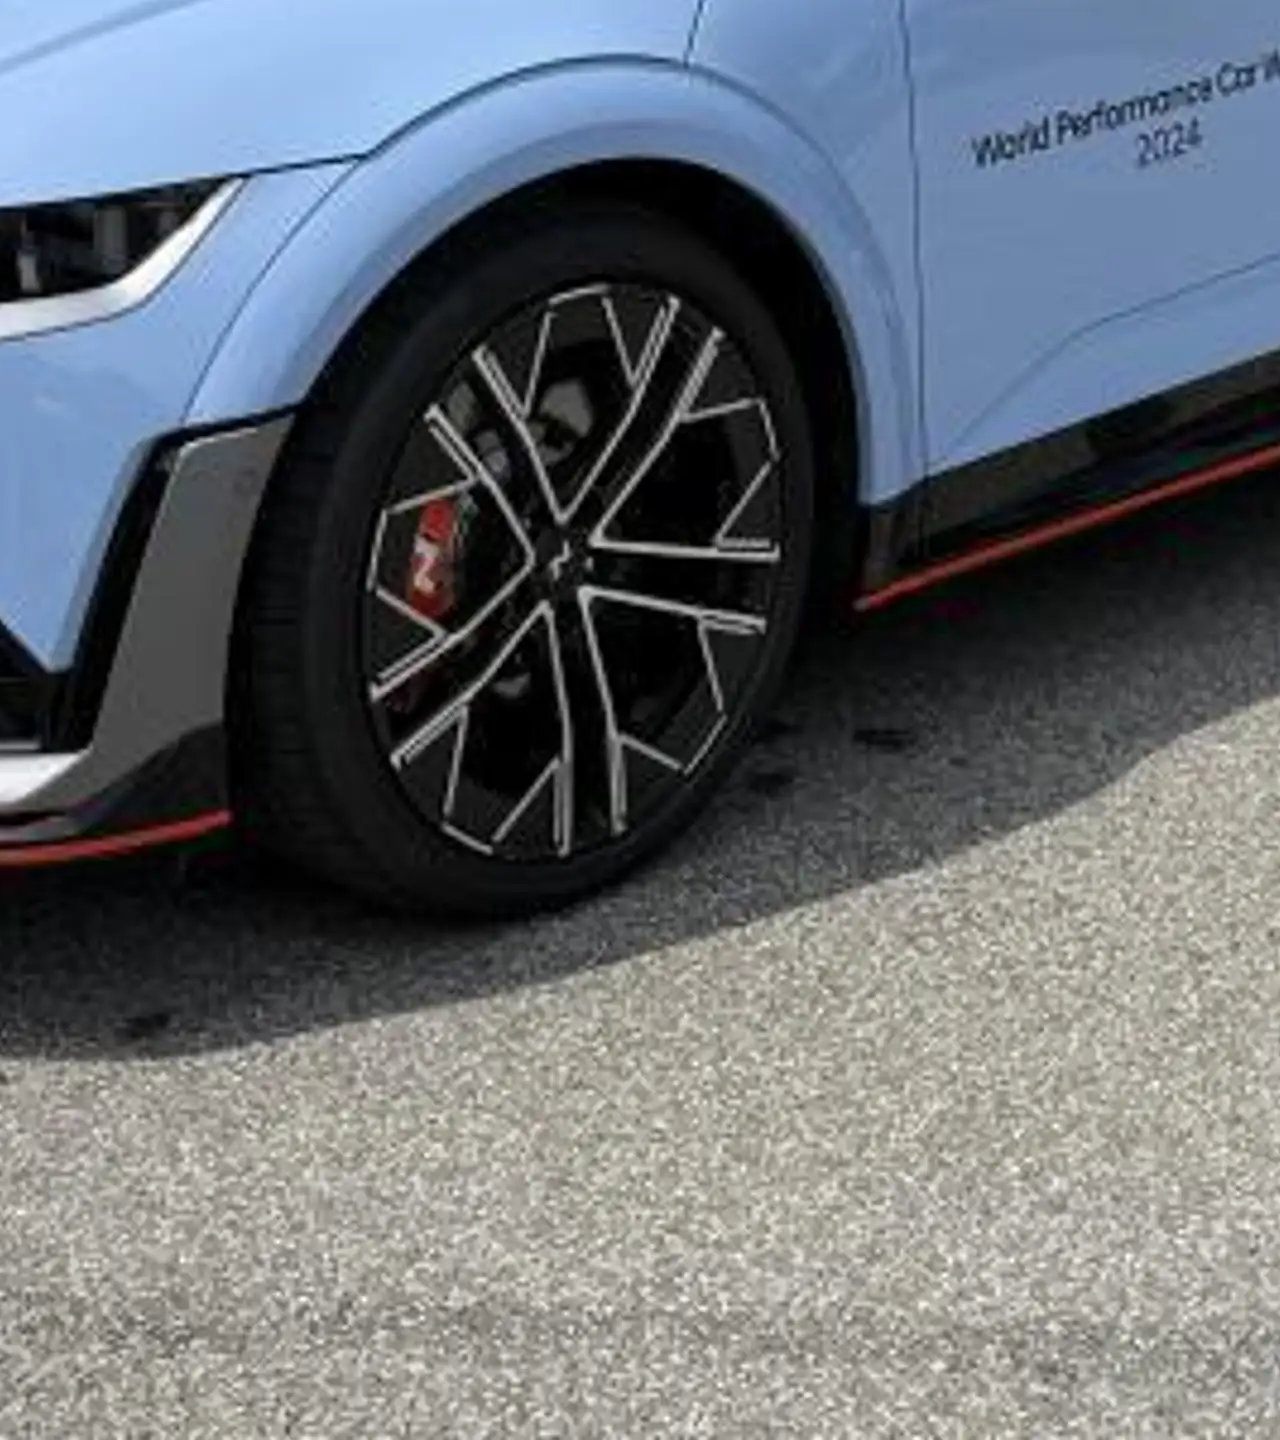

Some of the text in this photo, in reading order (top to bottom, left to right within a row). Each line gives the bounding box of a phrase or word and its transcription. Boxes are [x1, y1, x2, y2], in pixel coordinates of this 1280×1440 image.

[971, 116, 1050, 167] World
[1055, 75, 1214, 146] Performance
[1216, 62, 1256, 97] Car
[1135, 117, 1204, 168] 2024
